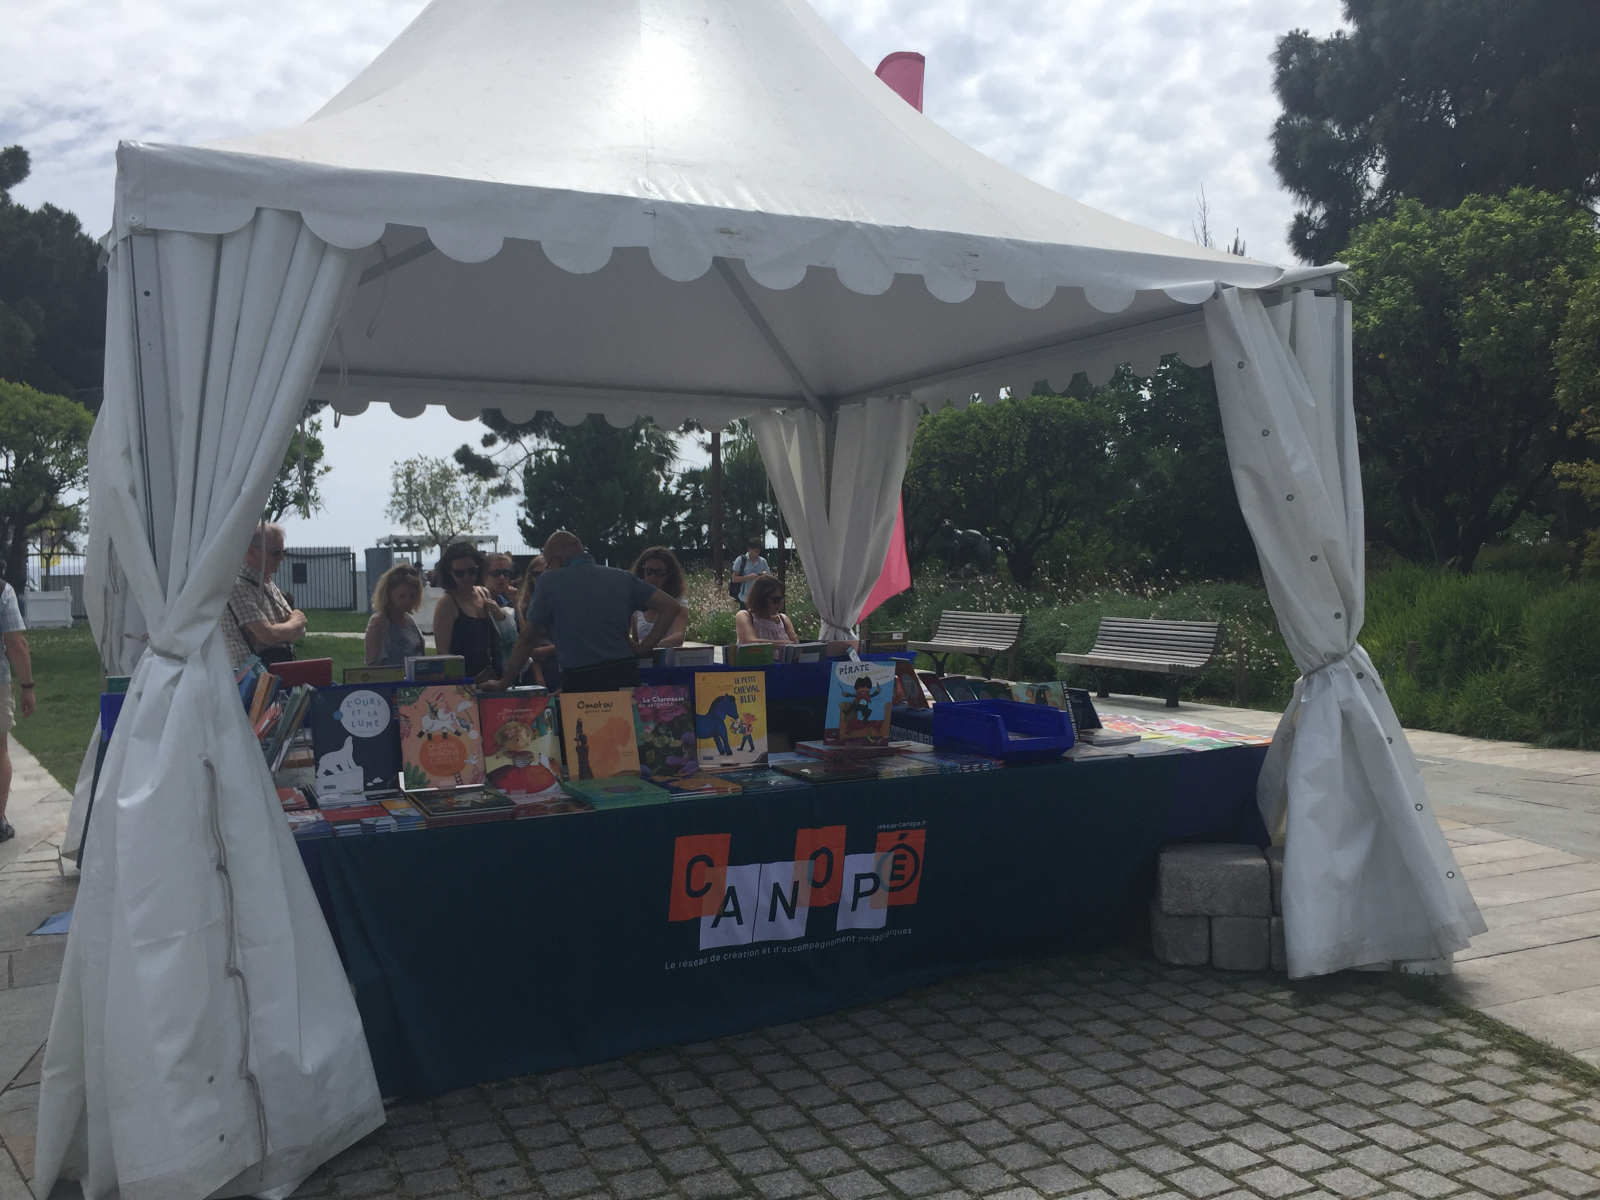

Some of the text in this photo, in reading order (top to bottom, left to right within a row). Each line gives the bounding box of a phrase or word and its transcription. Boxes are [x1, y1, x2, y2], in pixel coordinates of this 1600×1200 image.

[741, 675, 757, 684] PETIT
[733, 684, 760, 694] CHEVAL
[347, 697, 382, 708] L'OURS
[740, 695, 756, 703] BLEU
[576, 700, 614, 710] Omotou
[351, 709, 361, 717] ET
[351, 719, 381, 728] LUNE
[665, 961, 676, 970] Le
[678, 956, 708, 968] réseau
[710, 953, 721, 962] de
[723, 949, 760, 961] création
[762, 946, 771, 954] et
[773, 935, 856, 953] d'accompagnement
